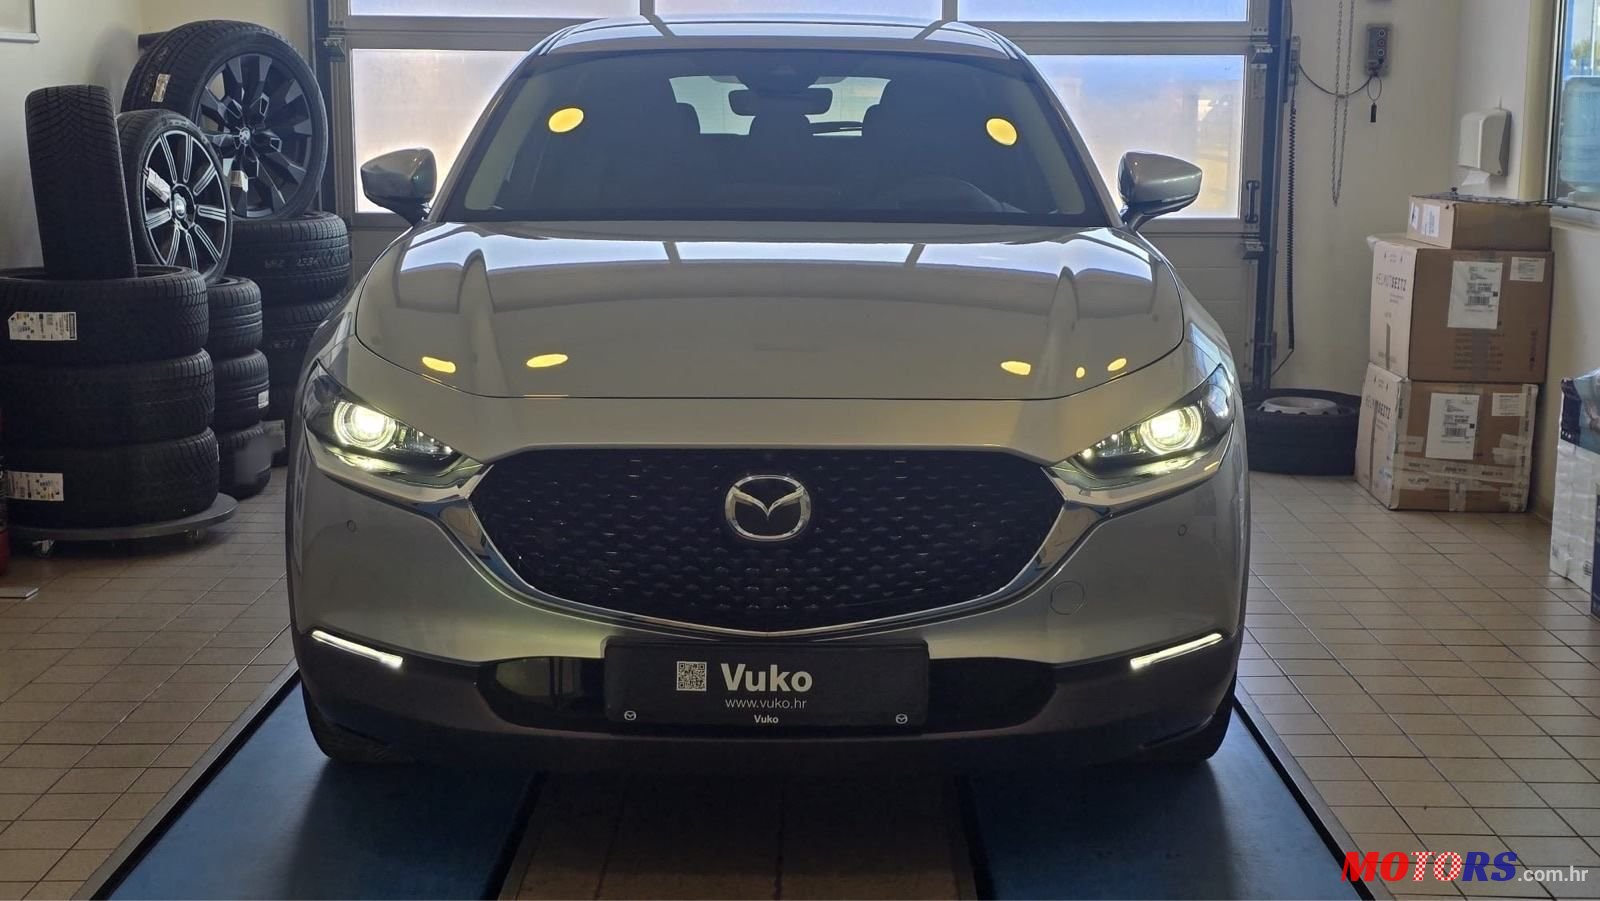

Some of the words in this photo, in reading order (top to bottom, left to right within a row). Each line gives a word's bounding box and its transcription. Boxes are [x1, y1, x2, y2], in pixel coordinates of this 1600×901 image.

[720, 663, 813, 693] Vuko
[725, 697, 808, 709] www.vuko.hr
[753, 713, 780, 724] Vuko
